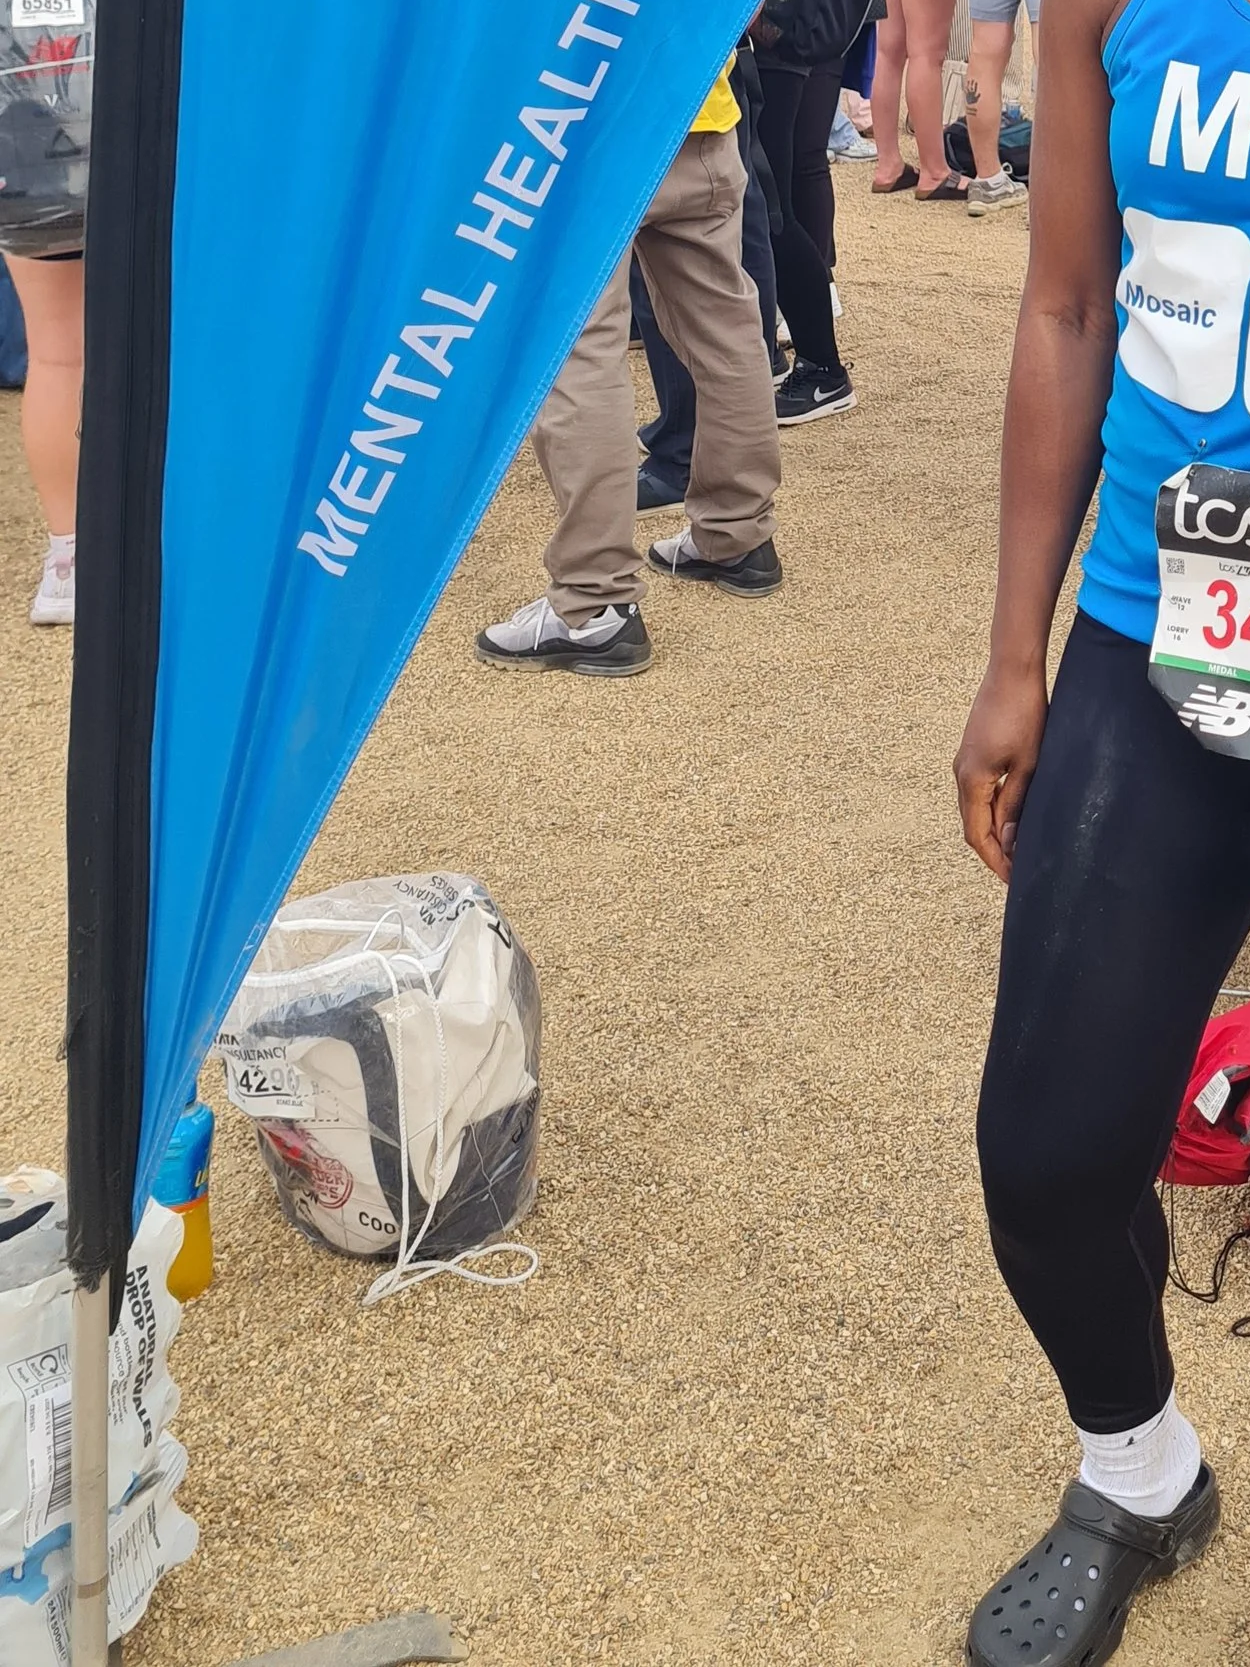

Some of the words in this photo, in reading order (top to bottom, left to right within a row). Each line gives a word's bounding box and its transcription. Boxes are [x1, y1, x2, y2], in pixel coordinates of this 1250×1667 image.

[1125, 280, 1217, 329] Mosaic
[297, 281, 497, 578] MENTAL
[1167, 624, 1189, 634] LORRY
[1208, 663, 1238, 677] MEDAL
[215, 1033, 239, 1046] ATA
[135, 1265, 147, 1279] A
[126, 1272, 145, 1331] DROP
[137, 1337, 148, 1366] OF
[139, 1281, 156, 1387] NATURAL
[132, 1370, 152, 1449] WALES
